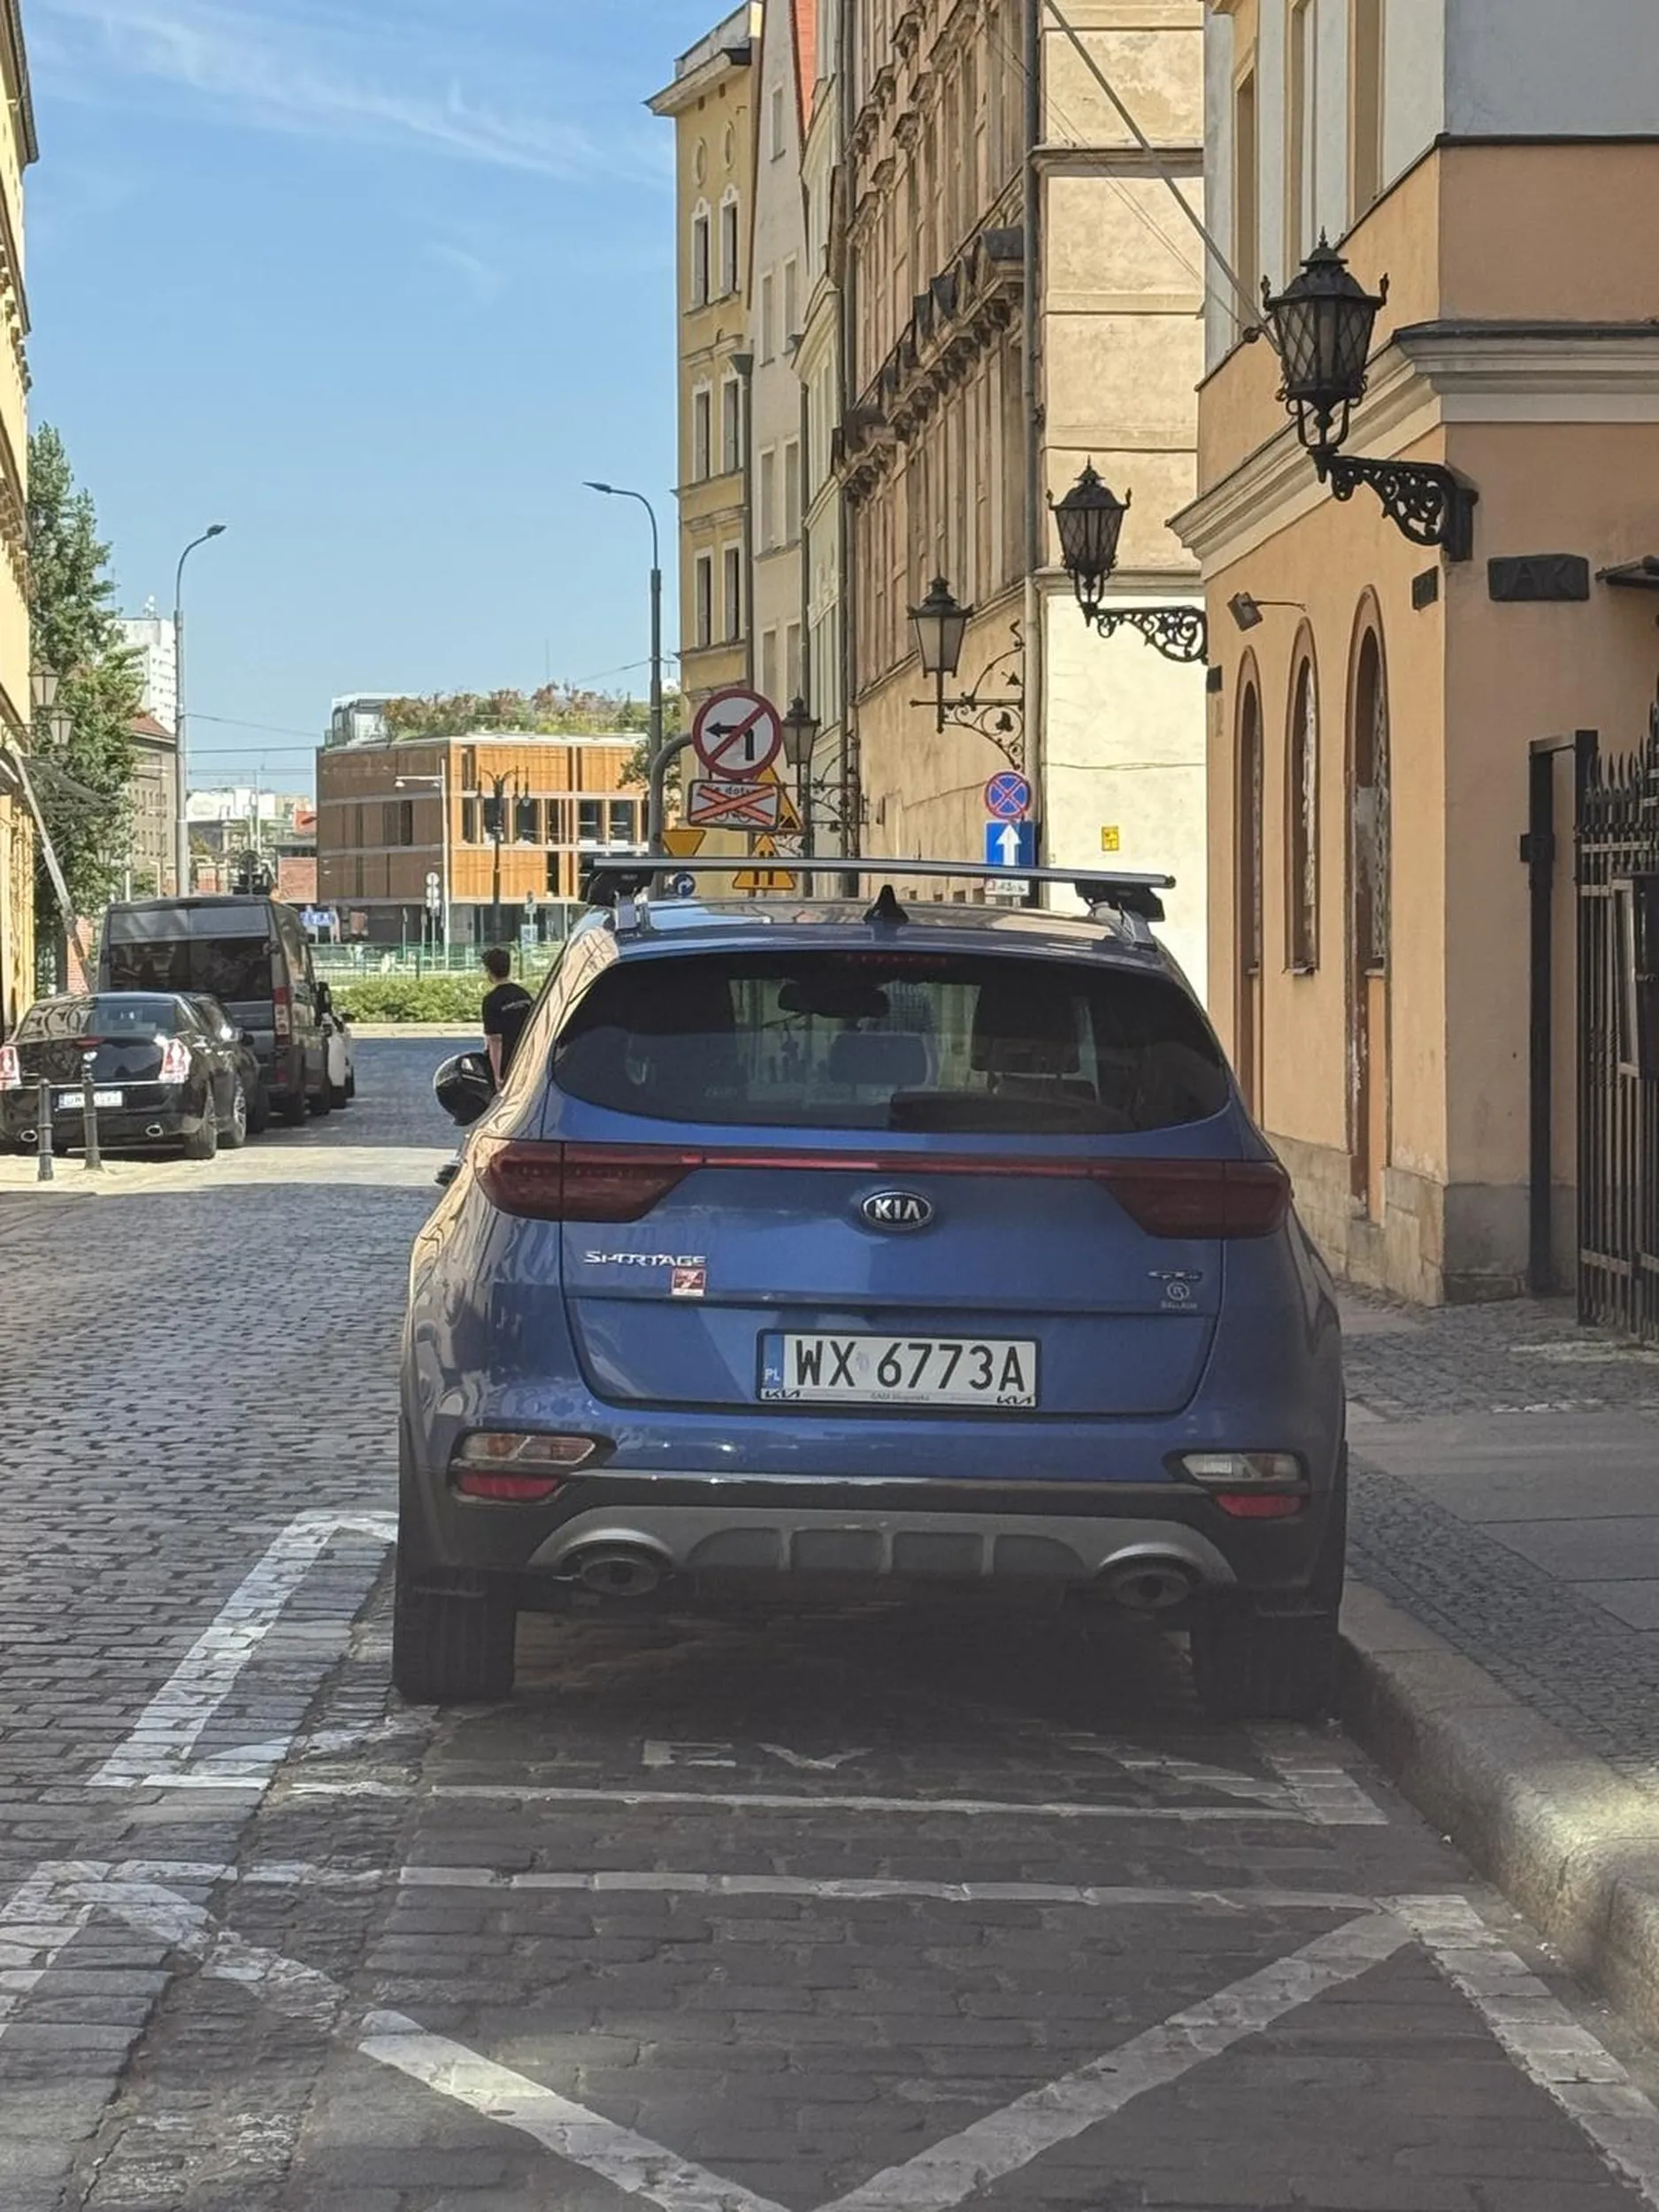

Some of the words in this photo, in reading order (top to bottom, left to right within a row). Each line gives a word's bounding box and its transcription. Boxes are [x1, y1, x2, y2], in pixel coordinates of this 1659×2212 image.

[875, 1199, 920, 1219] KIA
[764, 1368, 781, 1381] PL
[796, 1340, 856, 1386] WX
[877, 1342, 1025, 1392] 6773A
